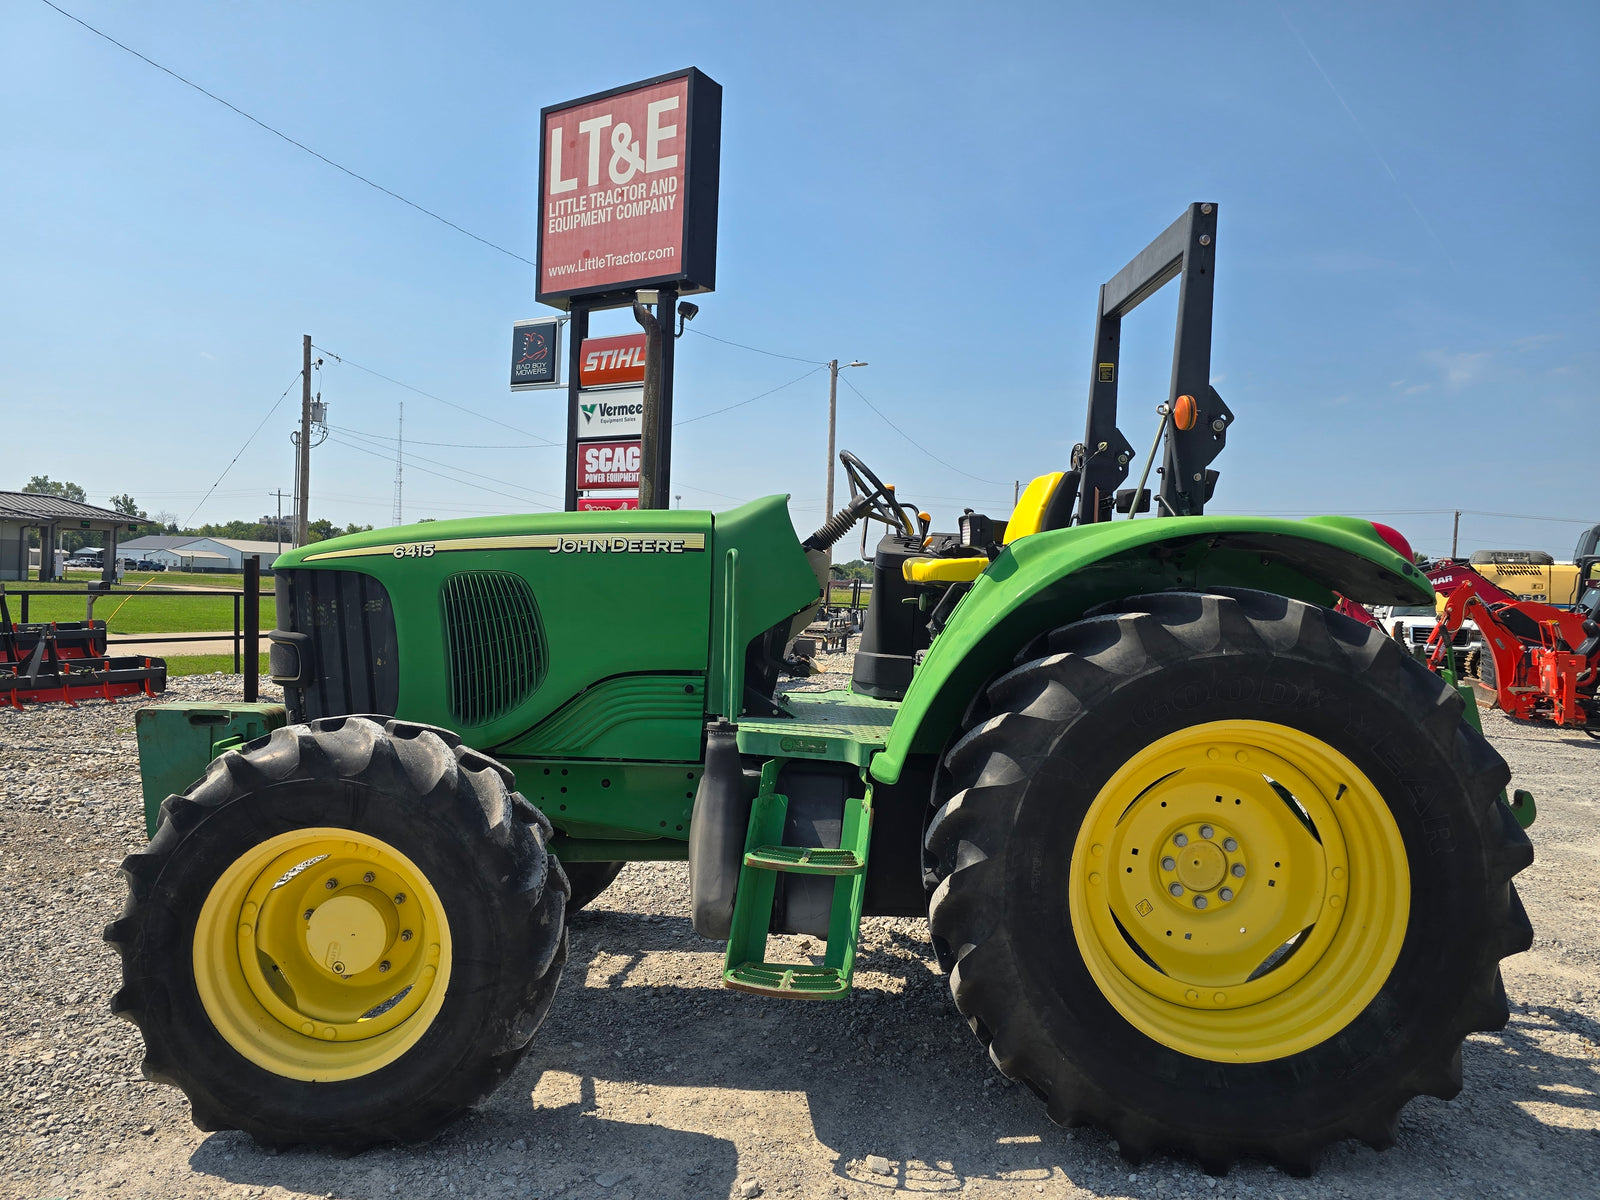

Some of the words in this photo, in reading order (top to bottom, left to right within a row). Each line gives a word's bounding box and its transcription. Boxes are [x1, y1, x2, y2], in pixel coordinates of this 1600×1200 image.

[549, 95, 679, 195] LT&E
[549, 194, 587, 218] LITTLE
[590, 183, 647, 210] TRACTOR
[649, 176, 678, 195] AND
[548, 207, 613, 234] EQUIPMENT
[616, 194, 677, 221] COMPANY
[548, 246, 675, 277] www.LittleTractor.com
[516, 363, 531, 371] BAD
[583, 346, 646, 372] STIHL
[515, 367, 547, 377] MOWERS
[598, 402, 643, 417] Vermee
[585, 446, 640, 472] SCAG
[585, 473, 605, 484] POWER
[606, 472, 640, 483] EQUIPMENT
[392, 543, 436, 559] 6415
[549, 537, 607, 554] JOHN
[610, 537, 684, 553] DEERE
[1430, 575, 1453, 586] MAR
